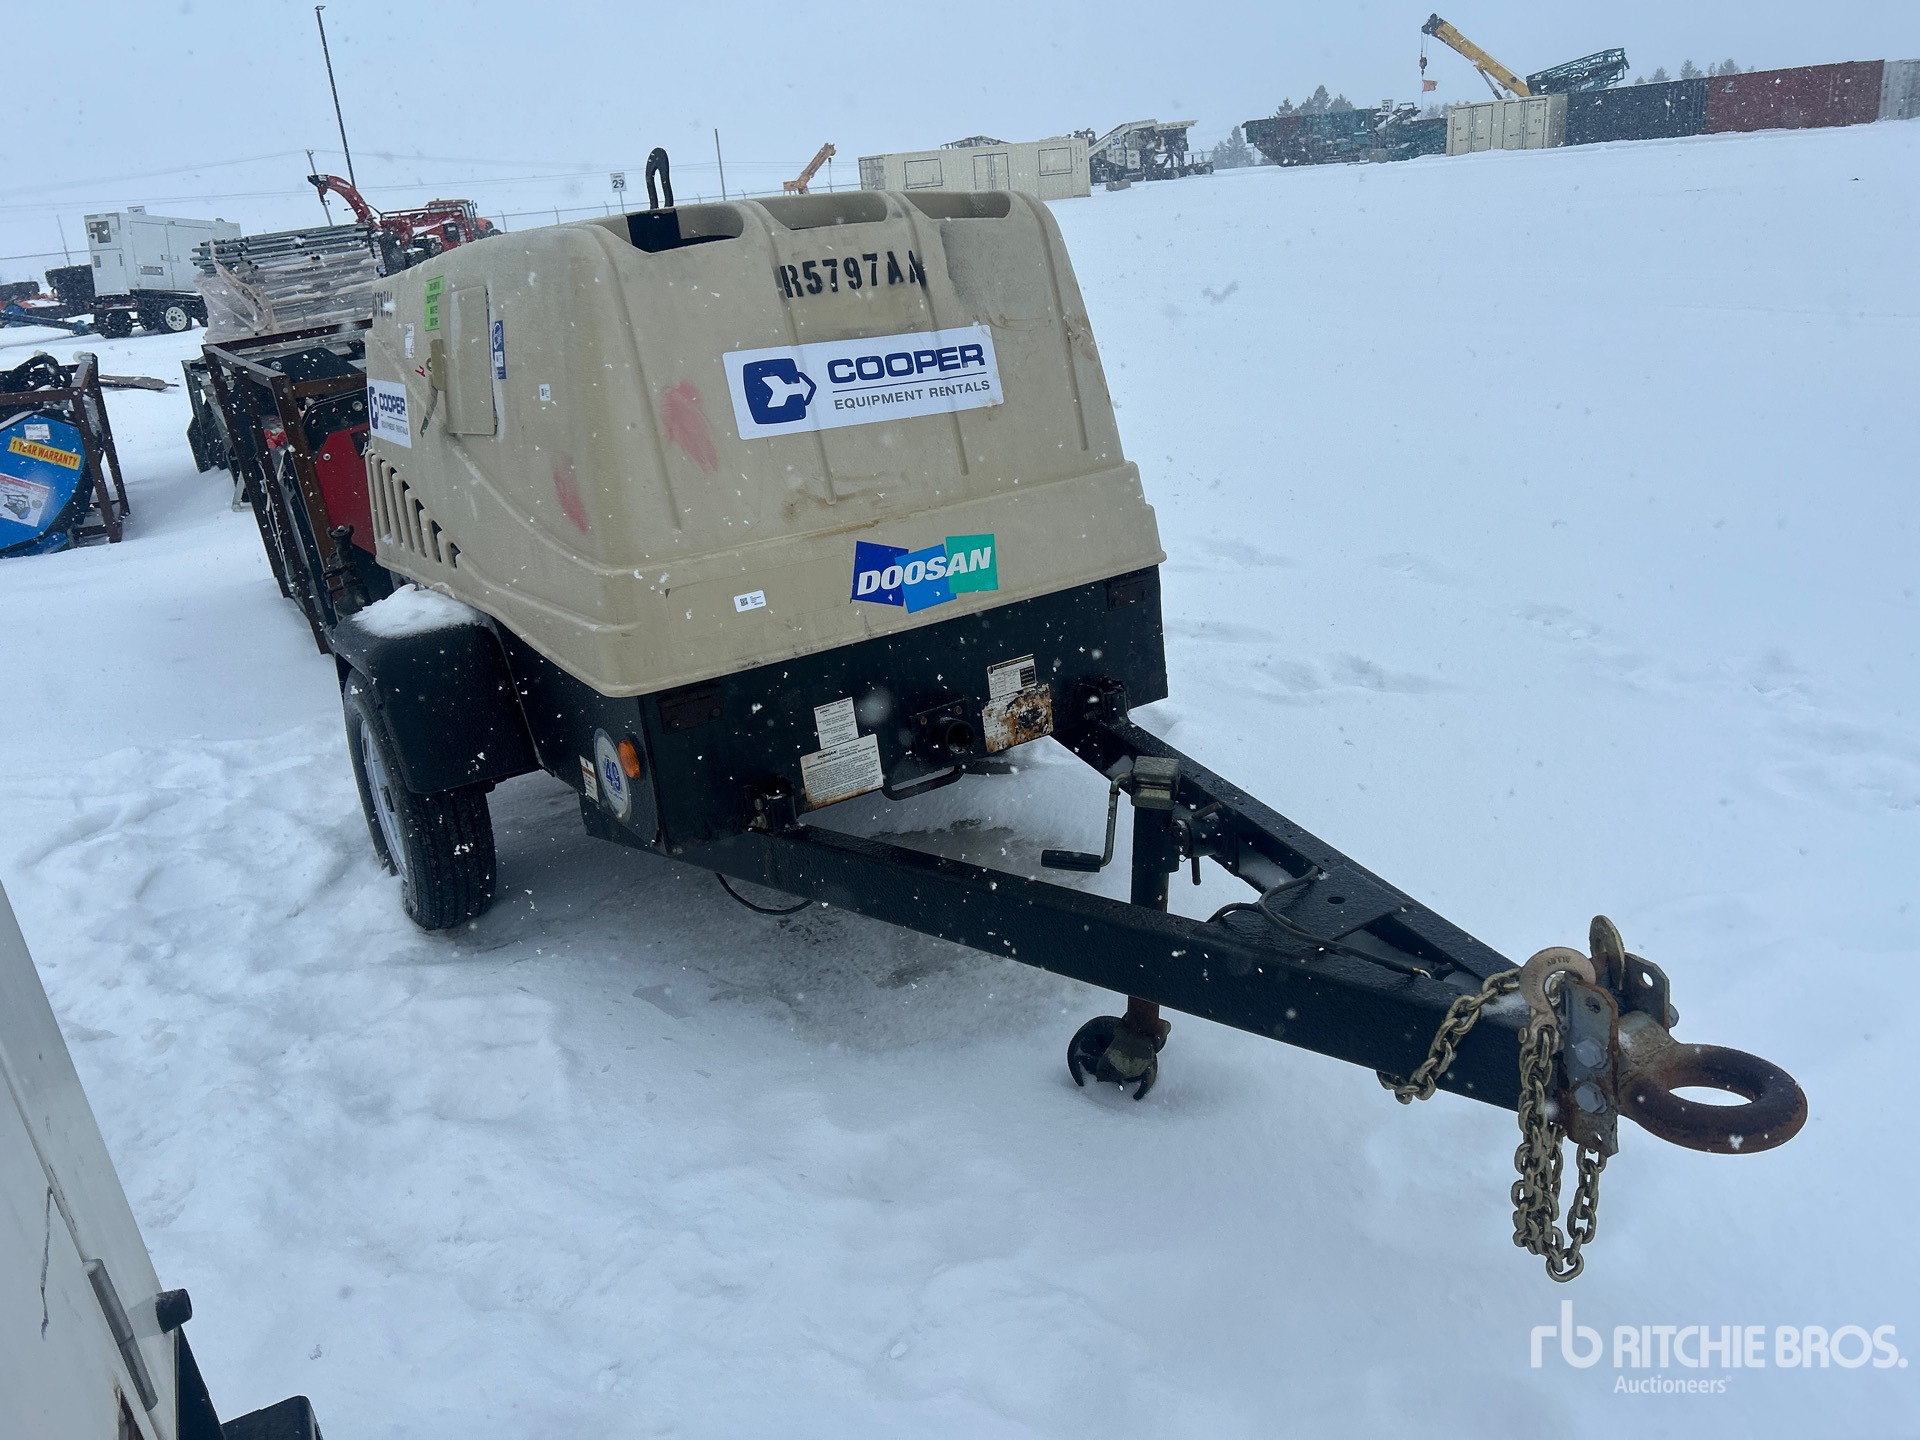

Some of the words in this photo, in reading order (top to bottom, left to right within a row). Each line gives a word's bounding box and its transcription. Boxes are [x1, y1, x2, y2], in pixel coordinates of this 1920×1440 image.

[612, 179, 625, 188] 29
[827, 344, 985, 384] COOPER
[378, 392, 406, 414] COOPER
[834, 389, 923, 410] EQUIPMENT
[929, 380, 990, 398] RENTALS
[12, 440, 16, 449] 1
[18, 442, 38, 456] YEAR
[38, 448, 78, 466] WARRANTY
[857, 547, 991, 596] DOOSAN
